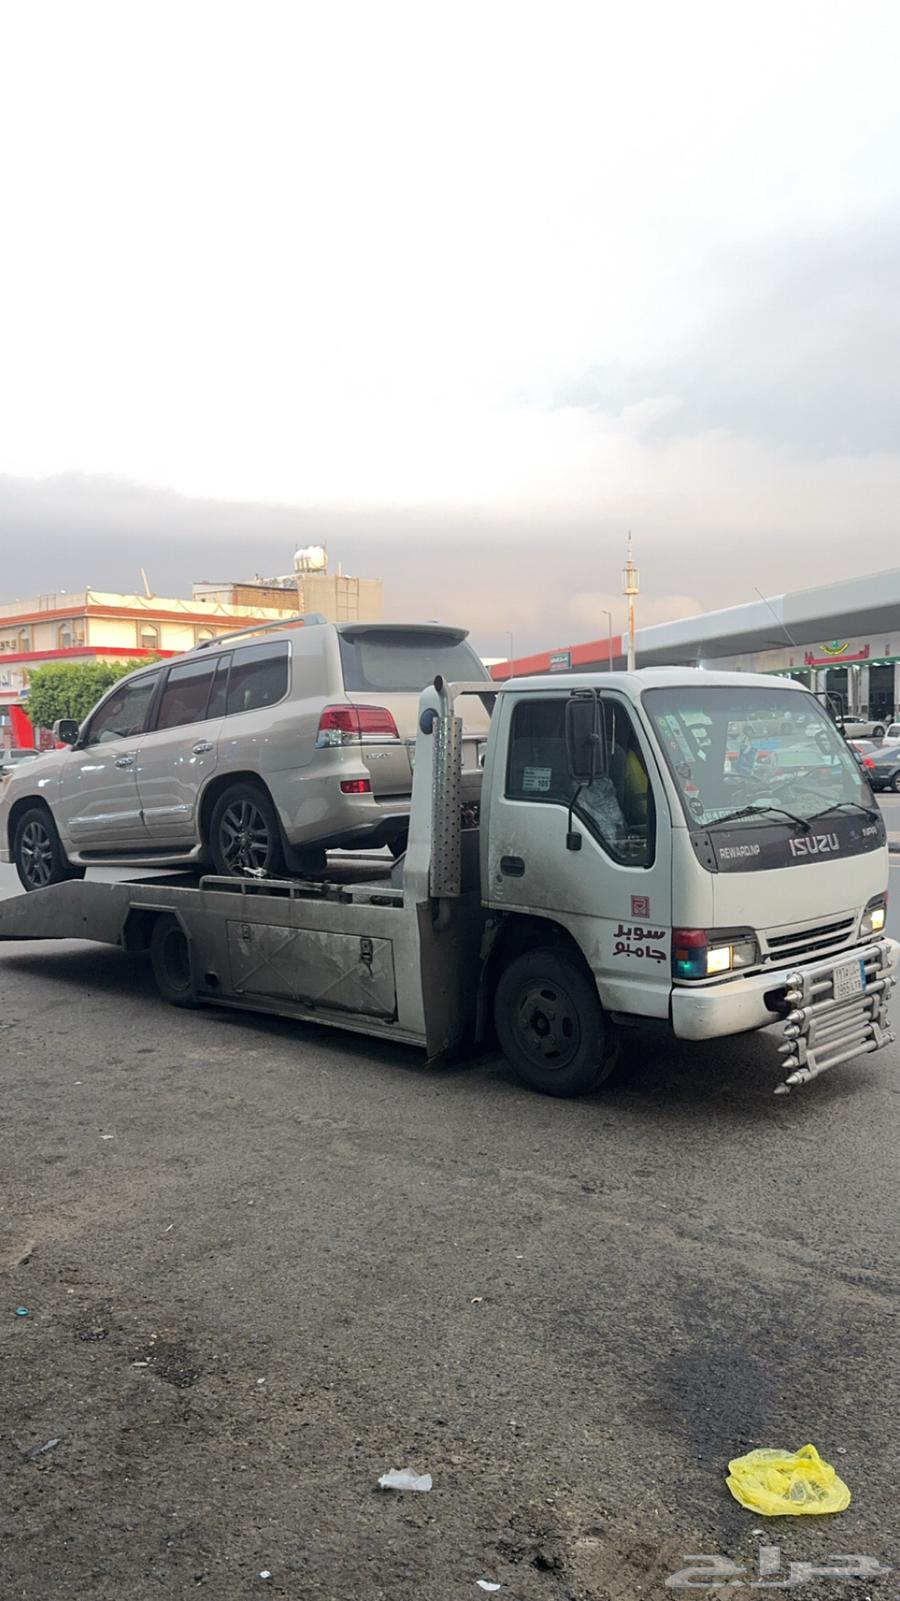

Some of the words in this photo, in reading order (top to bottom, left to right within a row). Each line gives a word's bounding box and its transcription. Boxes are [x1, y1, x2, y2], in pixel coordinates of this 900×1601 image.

[788, 833, 840, 857] ISUZU
[613, 924, 666, 941] سوبر
[613, 941, 667, 964] جامبو
